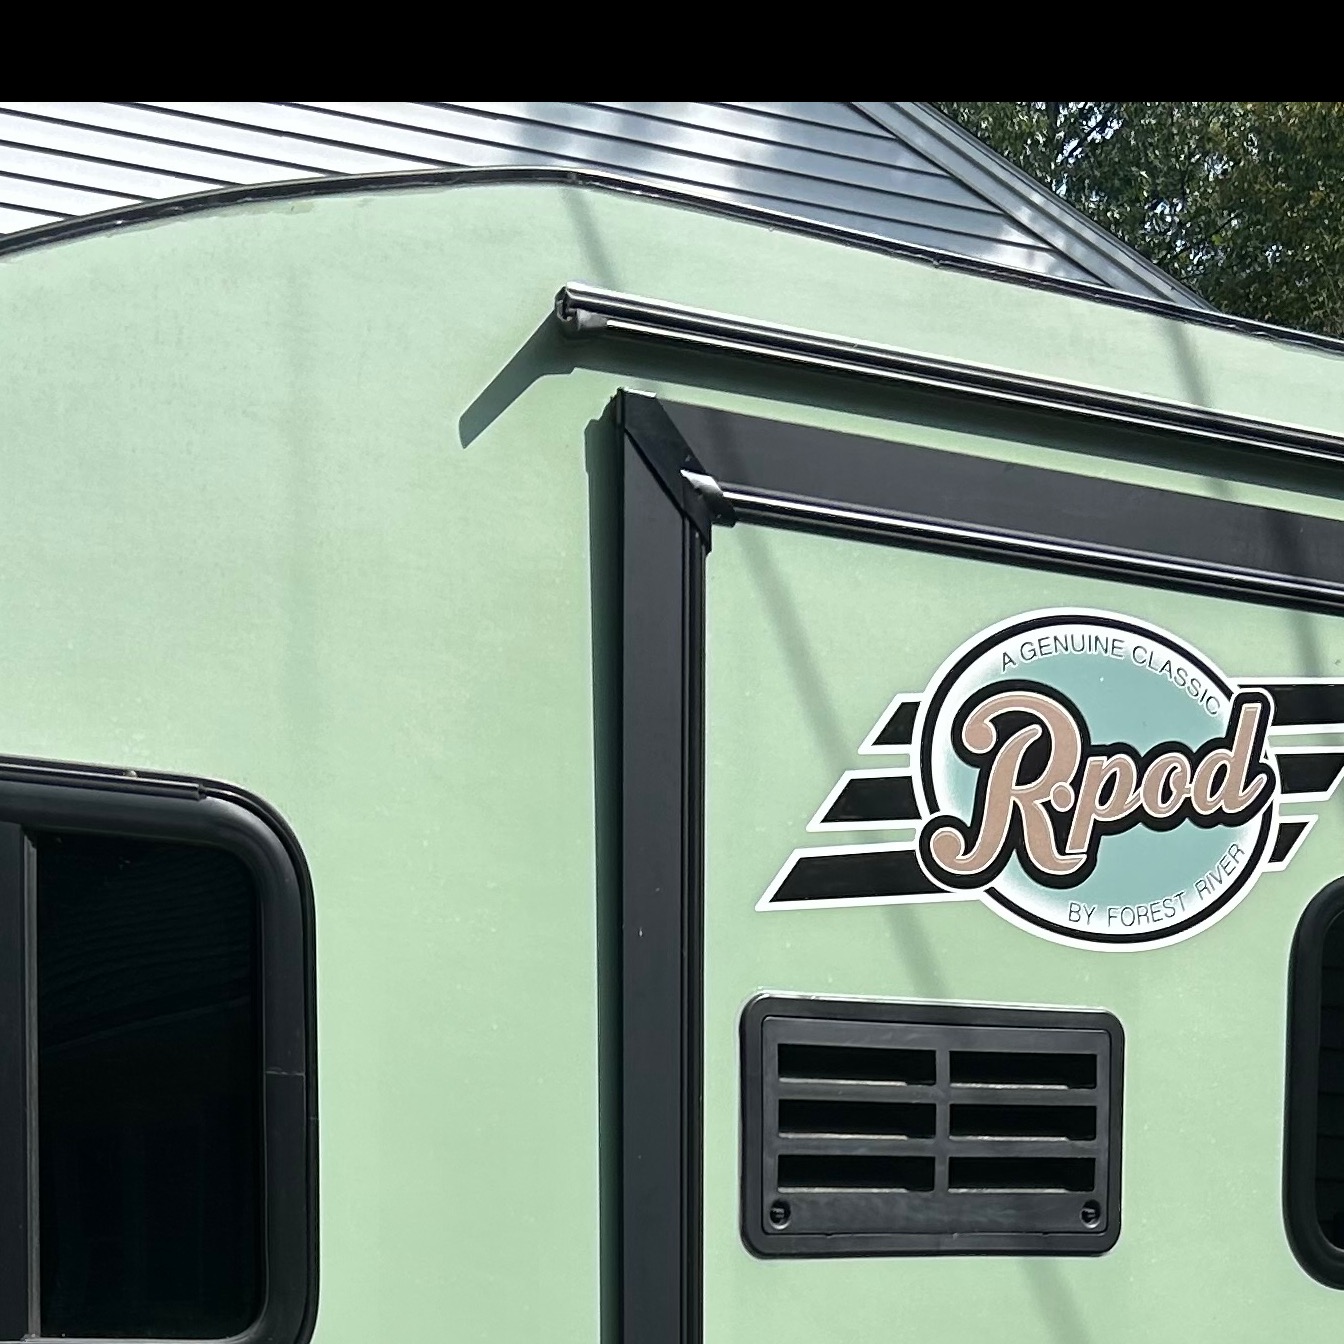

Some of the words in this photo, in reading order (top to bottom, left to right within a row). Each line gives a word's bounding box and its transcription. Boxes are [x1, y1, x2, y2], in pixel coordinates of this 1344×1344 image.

[1001, 651, 1016, 672] A
[1019, 633, 1126, 662] GENUINE
[1131, 645, 1221, 716] CLASSIC
[1067, 902, 1096, 926] BY
[1107, 891, 1186, 928] FOREST
[1193, 843, 1246, 901] RIVER
